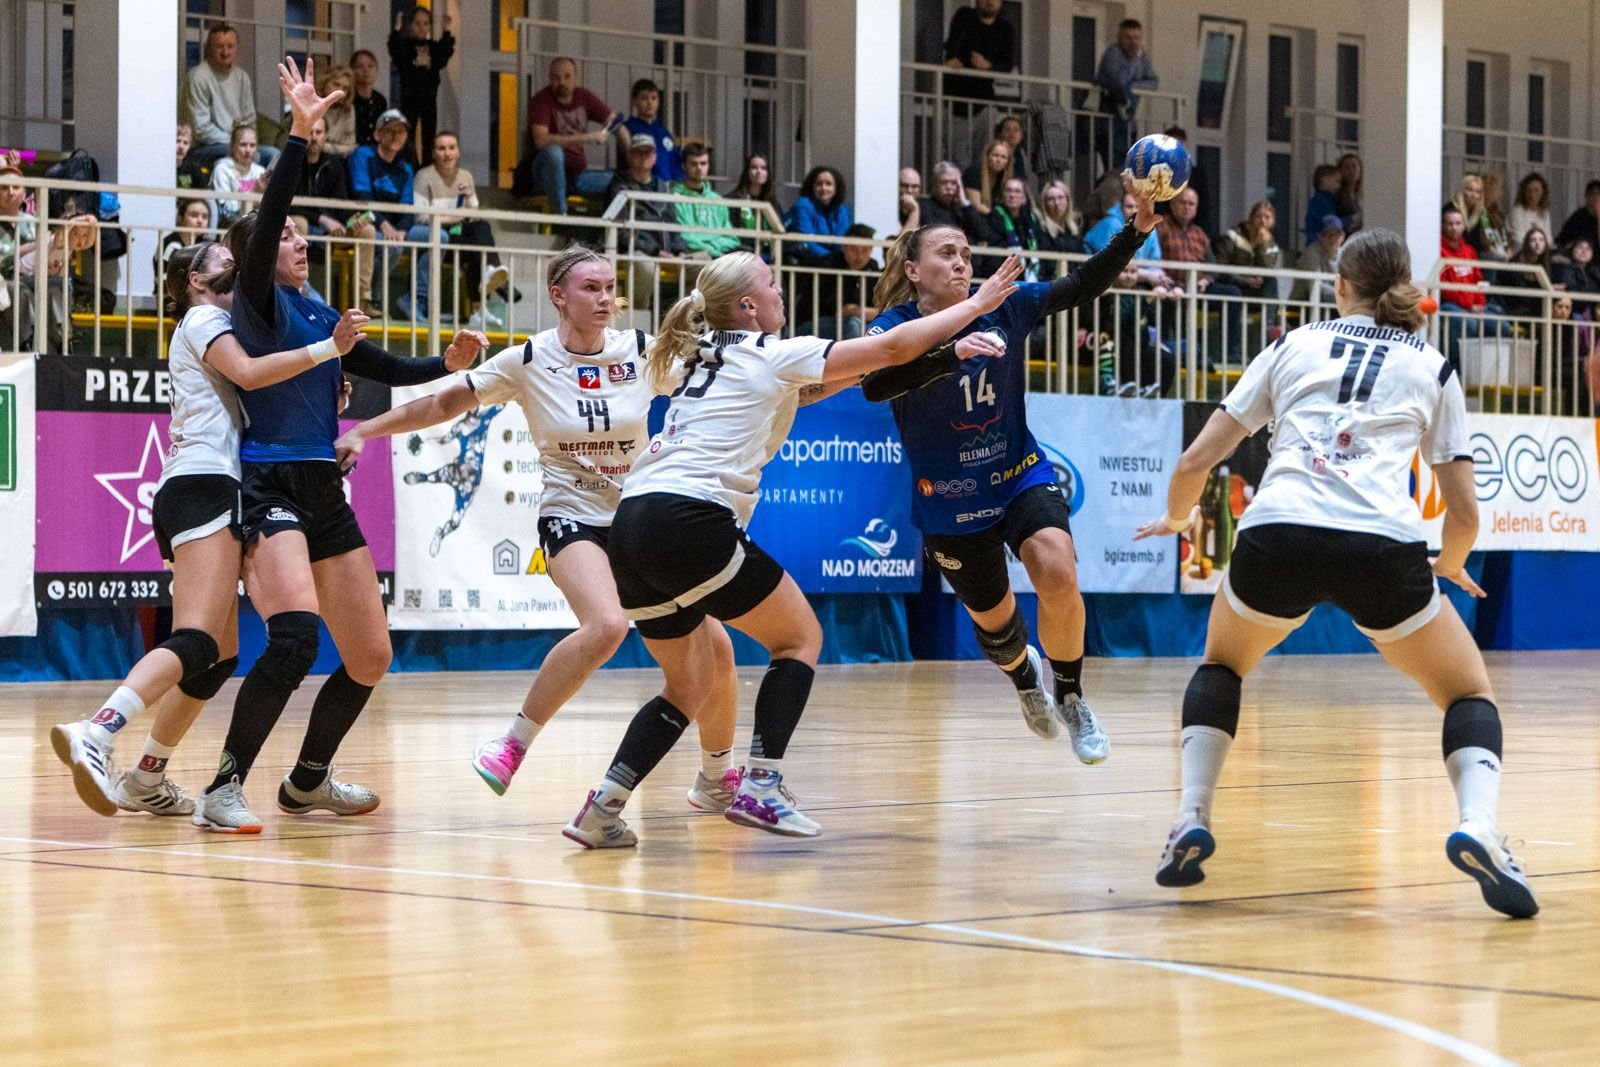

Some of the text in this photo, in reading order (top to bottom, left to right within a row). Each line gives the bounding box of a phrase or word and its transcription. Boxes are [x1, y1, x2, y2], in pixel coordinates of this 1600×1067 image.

[1329, 336, 1389, 404] 71
[959, 368, 996, 412] 14
[577, 399, 611, 433] 44
[558, 440, 615, 453] WESTMAR
[780, 434, 902, 467] apartments
[1099, 456, 1163, 473] INWESTUJ
[1469, 432, 1588, 503] eco
[934, 478, 977, 495] eco
[1110, 481, 1153, 498] Z NAMI
[1491, 510, 1587, 534] Jelenia Góra
[1104, 548, 1165, 566] bgizremb.pl
[822, 559, 855, 577] NAD
[857, 559, 915, 577] MORZEM
[68, 581, 159, 599] 501 672 332
